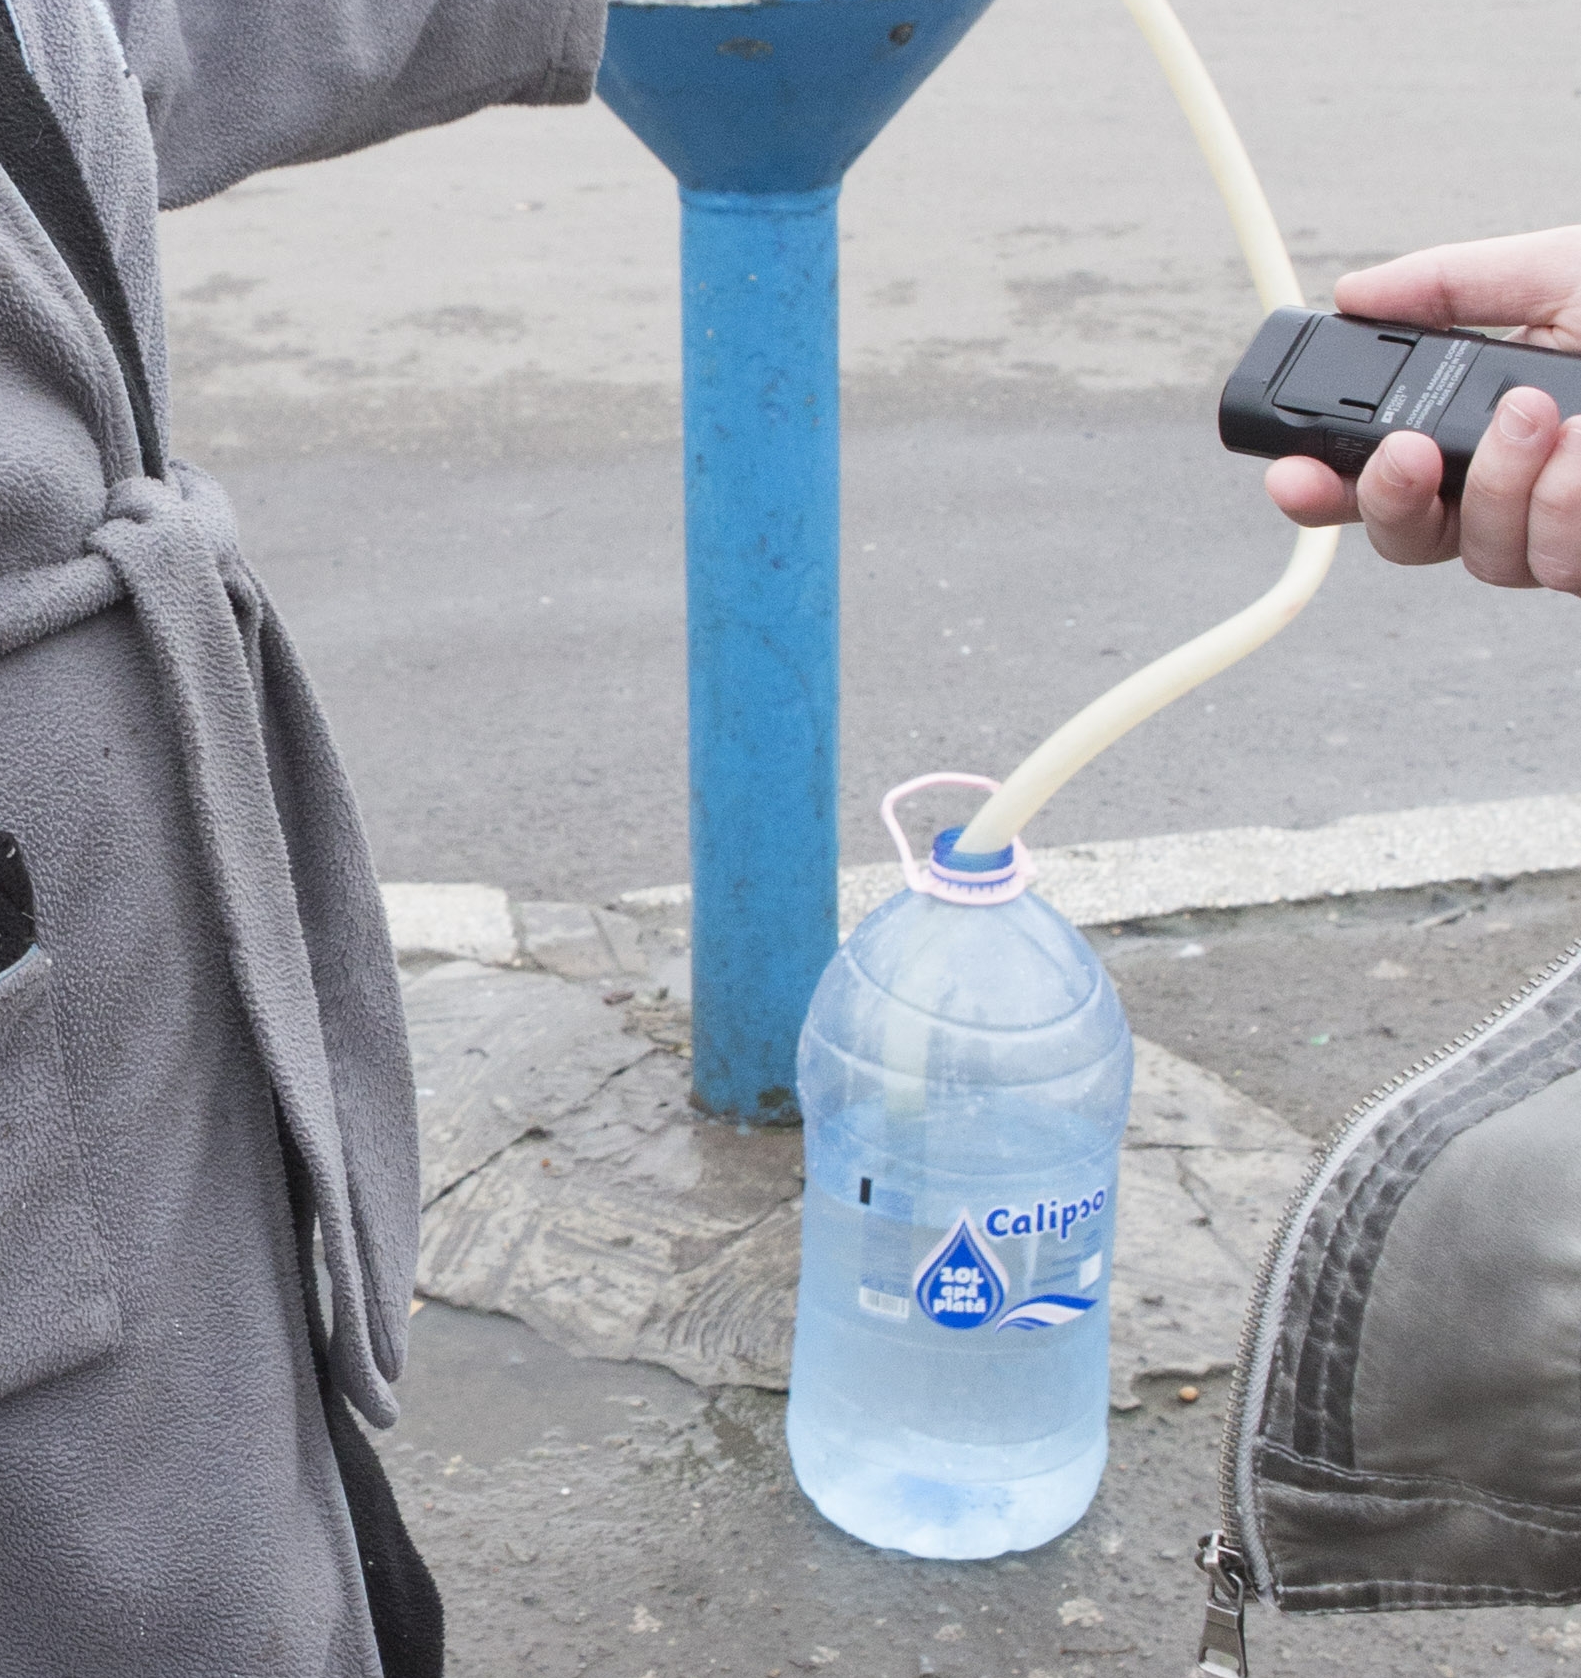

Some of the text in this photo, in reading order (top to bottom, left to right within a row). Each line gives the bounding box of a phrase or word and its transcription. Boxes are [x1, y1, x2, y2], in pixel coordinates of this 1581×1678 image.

[1396, 384, 1406, 394] TO
[1405, 392, 1430, 426] OLYMPUS
[1426, 361, 1448, 391] IMAGING
[1435, 364, 1457, 392] OLYMPUS
[1435, 363, 1467, 407] MADE IN CHINA
[985, 1189, 1106, 1240] Calipso
